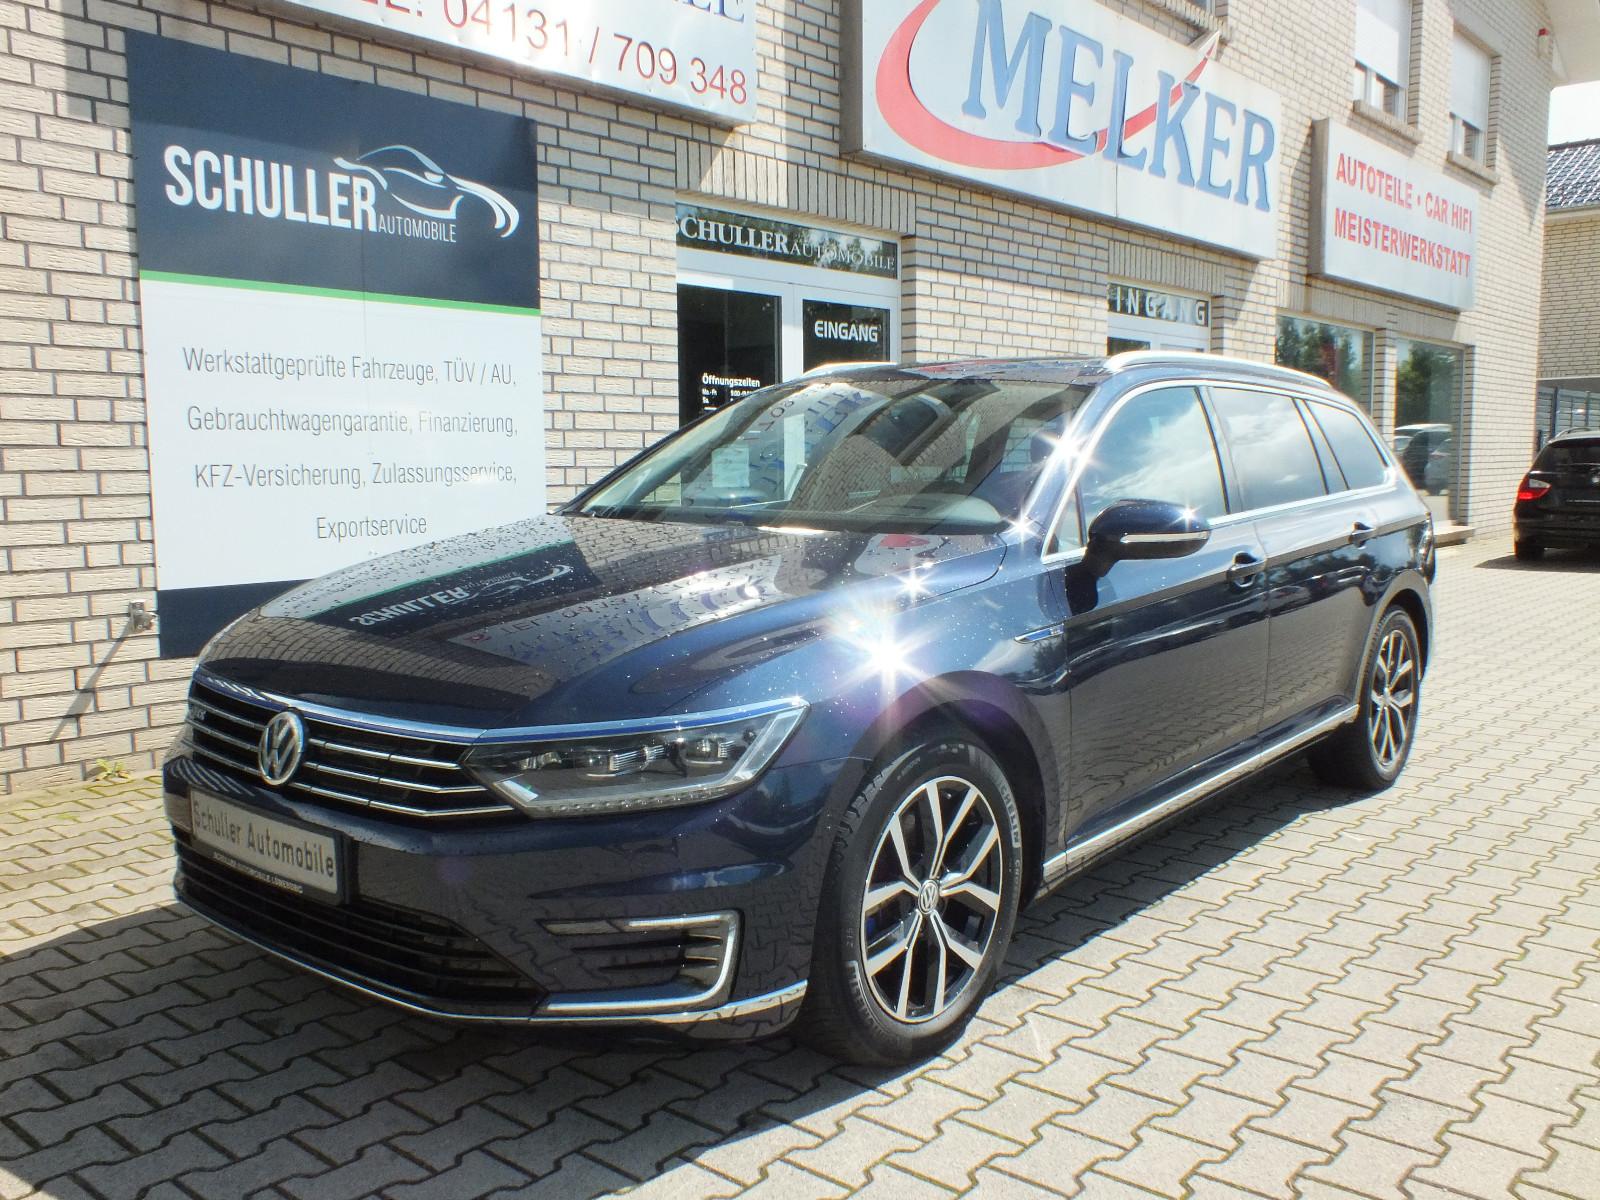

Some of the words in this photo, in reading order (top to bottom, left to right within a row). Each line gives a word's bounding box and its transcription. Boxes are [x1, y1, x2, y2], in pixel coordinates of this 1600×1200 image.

[613, 33, 677, 85] 709
[690, 57, 748, 104] 348
[961, 0, 1275, 213] MELKER
[164, 145, 377, 233] SCHULLER
[378, 216, 457, 243] AUTOMOBILE
[1335, 153, 1413, 210] AUTOTEILE
[1425, 191, 1449, 225] CAR
[1451, 203, 1473, 234] HIFI
[790, 241, 896, 271] AUTOMOBILE
[1334, 207, 1472, 278] MEISTERWERKSTATT
[814, 319, 879, 343] EINGANG
[182, 346, 346, 381] Werkstattgeprüfte
[352, 356, 438, 386] Fahrzeuge,
[444, 357, 476, 384] TÜV
[480, 362, 487, 386] /
[702, 372, 761, 388] Öffnungszeiten
[187, 405, 413, 437] Gebrauchtwagengarantie,
[418, 410, 518, 438] Finanzierung,
[194, 463, 367, 490] KFZ-Versicherung,
[371, 461, 518, 488] Zulassungsservice,
[316, 512, 427, 543] Exportservice
[192, 800, 242, 847] Schuller
[247, 821, 335, 878] Automobile
